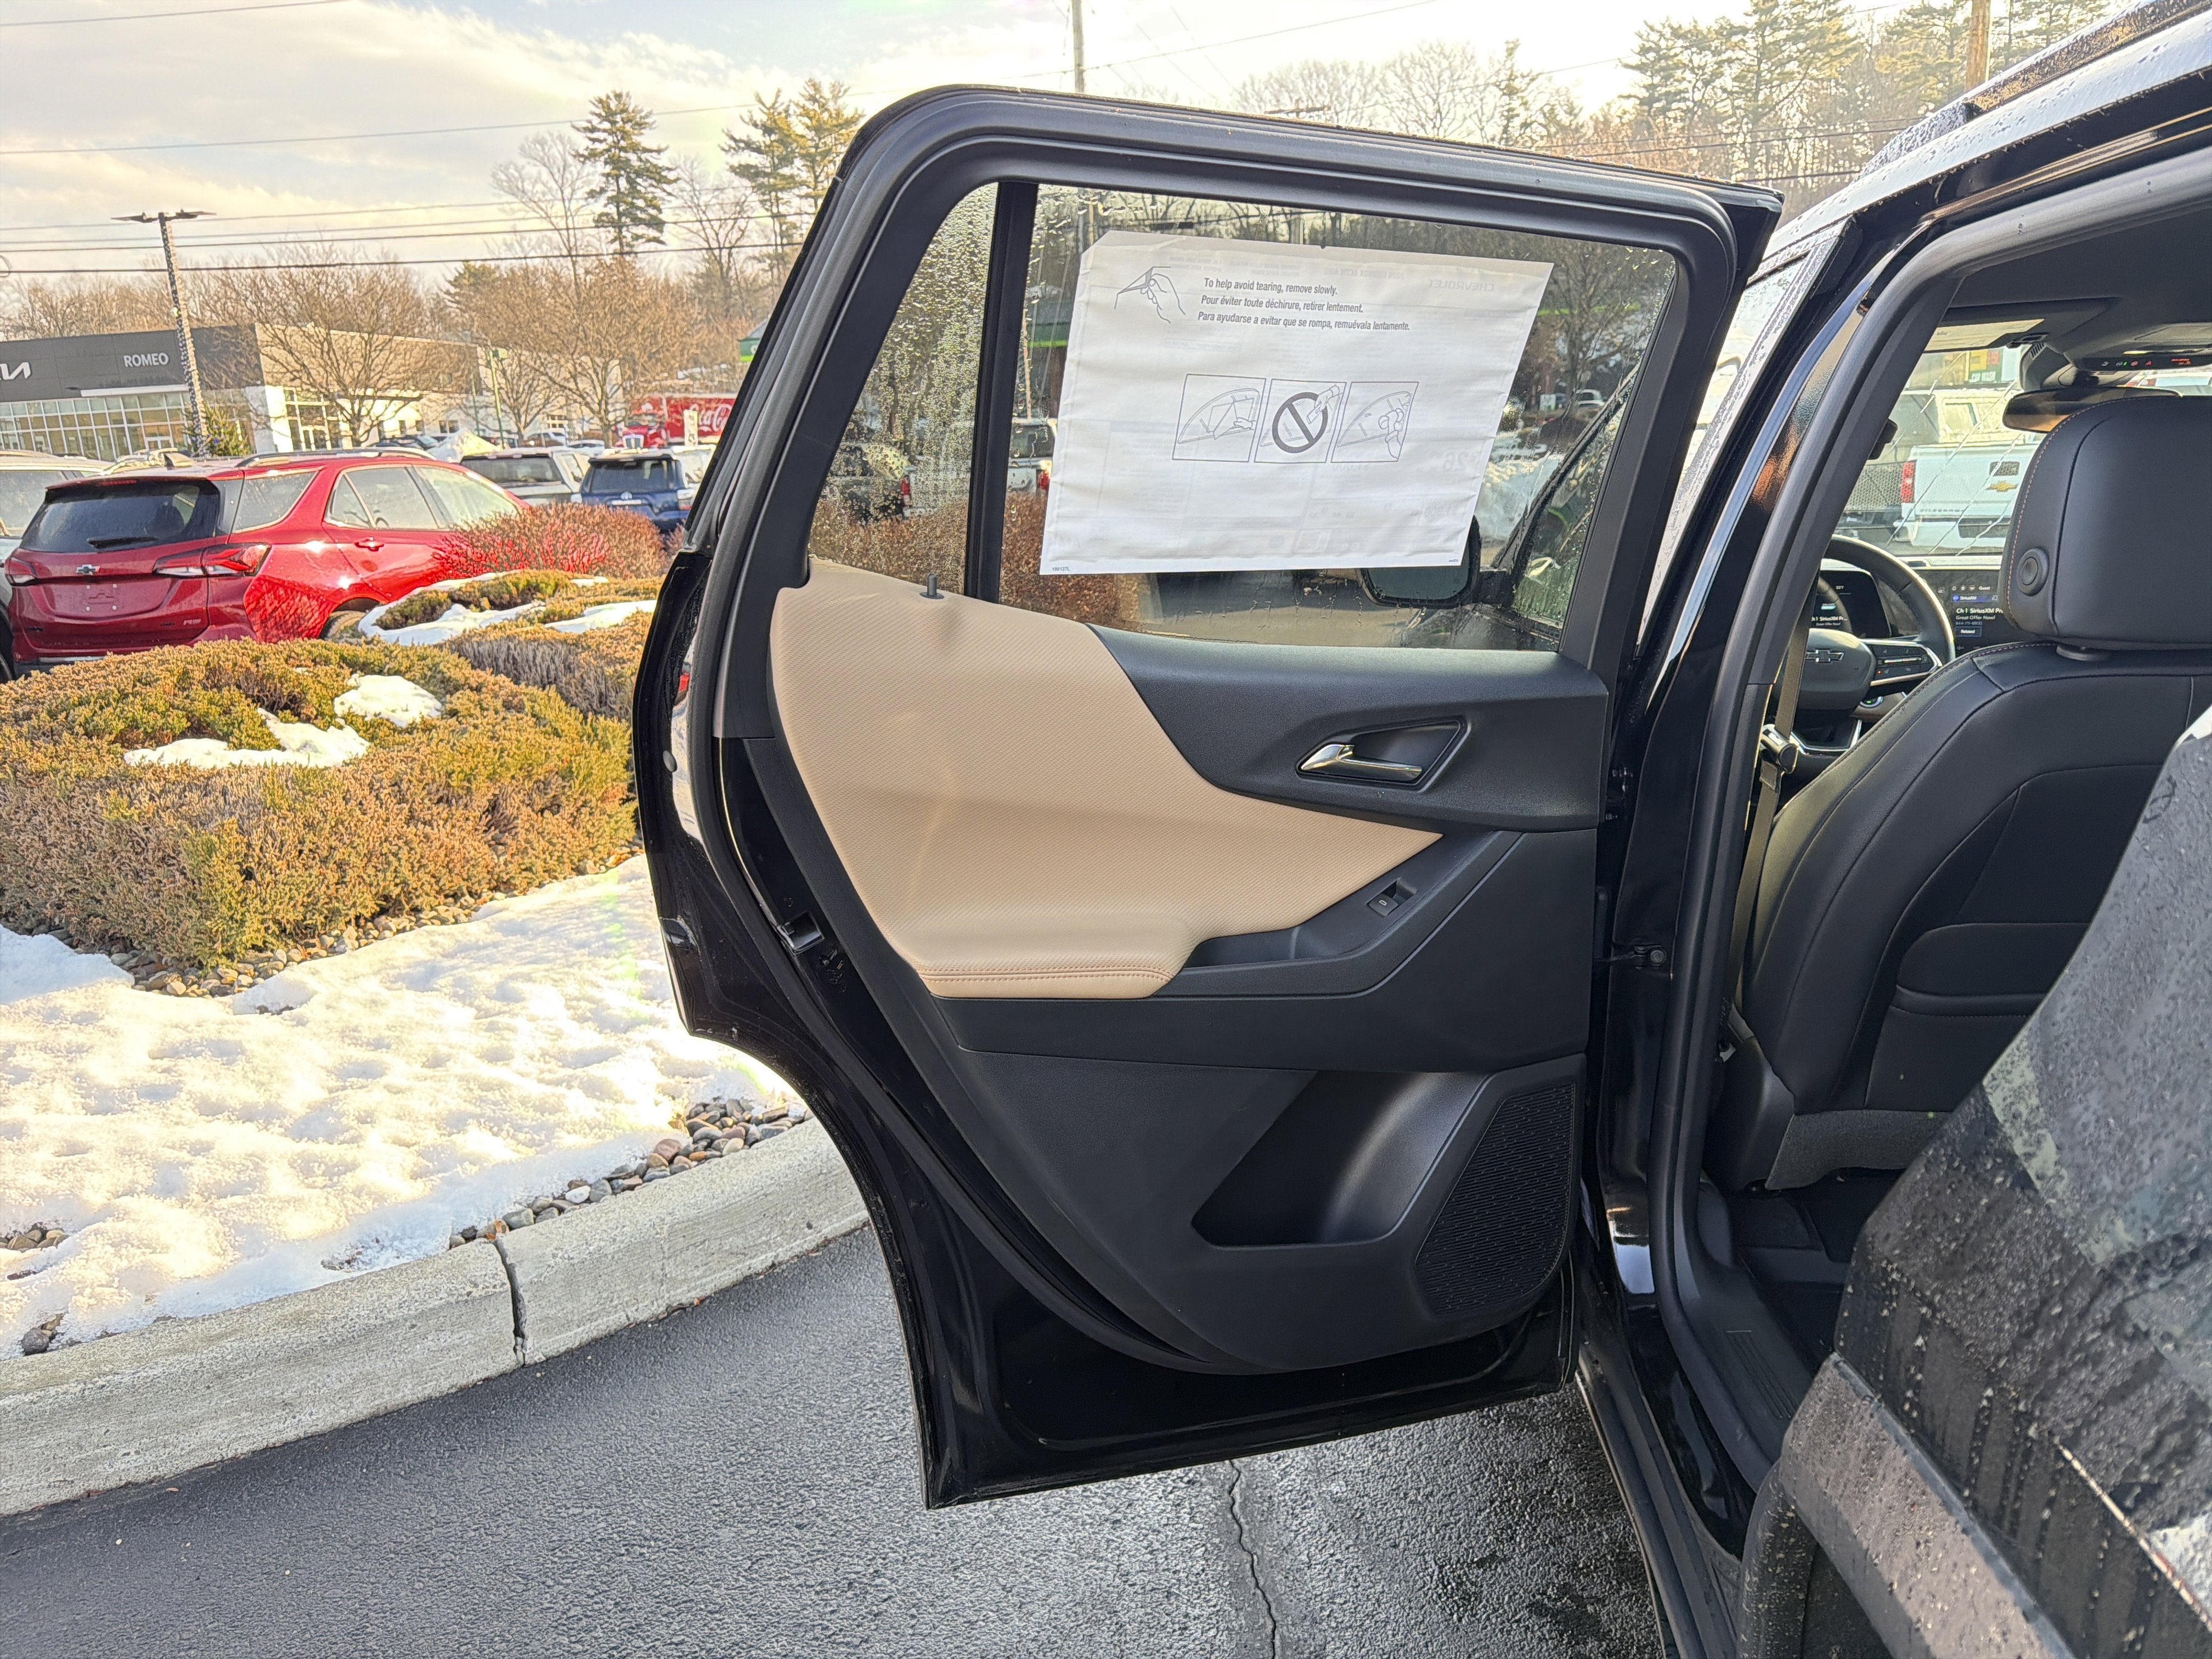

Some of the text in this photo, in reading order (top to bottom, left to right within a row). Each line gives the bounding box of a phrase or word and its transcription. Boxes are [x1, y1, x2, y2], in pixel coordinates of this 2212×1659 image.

[1204, 278, 1338, 296] To help avoid tearing, remove slowly.
[1201, 295, 1363, 313] Pour éviter toute déchirure, retirer lentement.
[1198, 312, 1215, 320] Para
[1216, 313, 1251, 323] ayudarse
[1261, 316, 1282, 325] evitar
[1283, 318, 1296, 328] que
[1308, 319, 1333, 329] rompa,
[1334, 320, 1371, 330] remuévala
[1373, 321, 1410, 330] lentamente.
[123, 352, 169, 368] ROMEO
